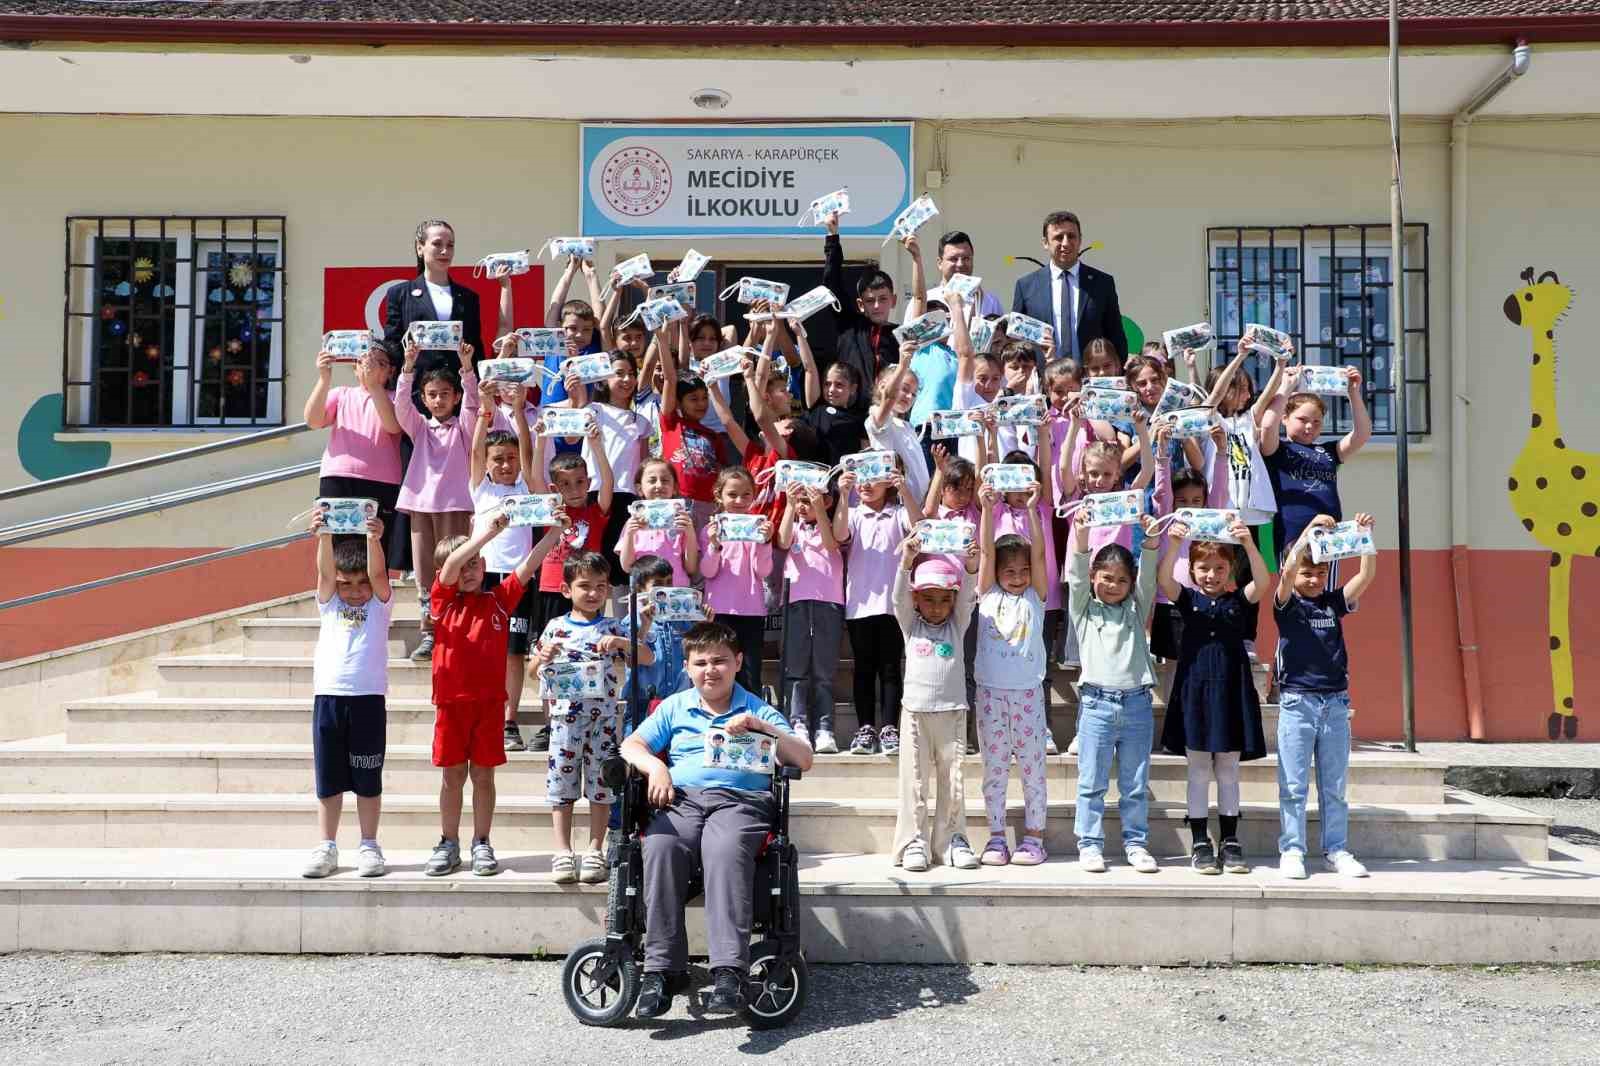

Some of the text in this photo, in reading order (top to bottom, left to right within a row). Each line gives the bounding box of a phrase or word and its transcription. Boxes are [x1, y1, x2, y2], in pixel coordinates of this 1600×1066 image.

[687, 148, 744, 160] SAKARYA
[755, 147, 840, 163] KARAPÜRÇEK
[687, 166, 795, 188] MECİDİYE
[687, 195, 799, 217] İLKOKULU
